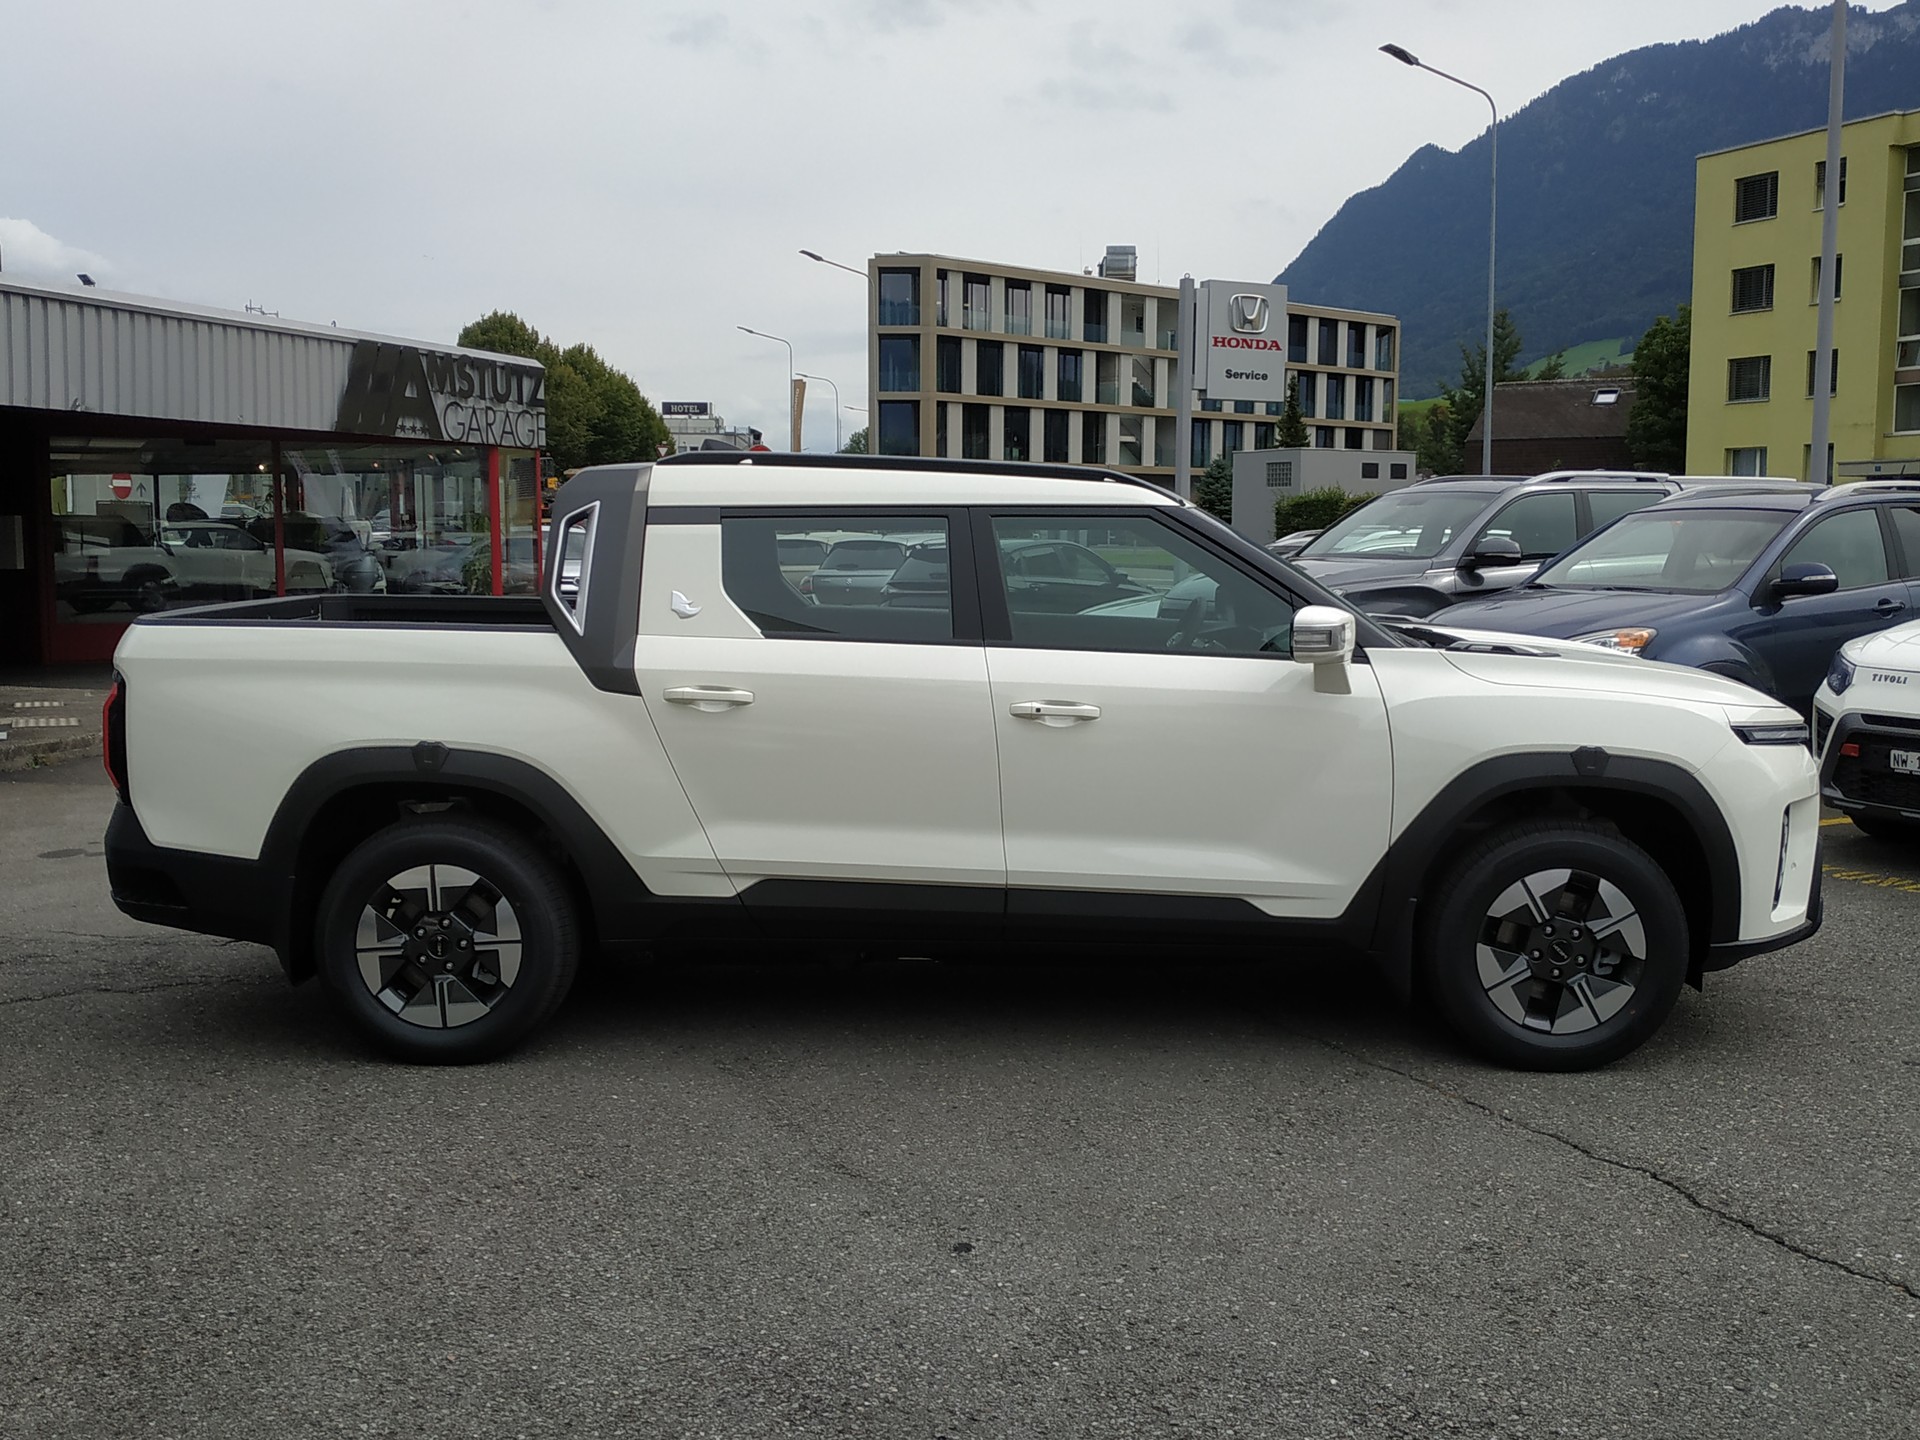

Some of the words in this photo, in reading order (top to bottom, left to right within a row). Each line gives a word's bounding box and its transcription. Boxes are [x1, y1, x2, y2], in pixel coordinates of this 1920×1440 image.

[1212, 336, 1282, 351] HONDA
[1225, 369, 1268, 381] Service
[670, 404, 700, 413] HOTEL
[443, 401, 546, 448] GARAGE
[1871, 673, 1908, 685] TIVOLI
